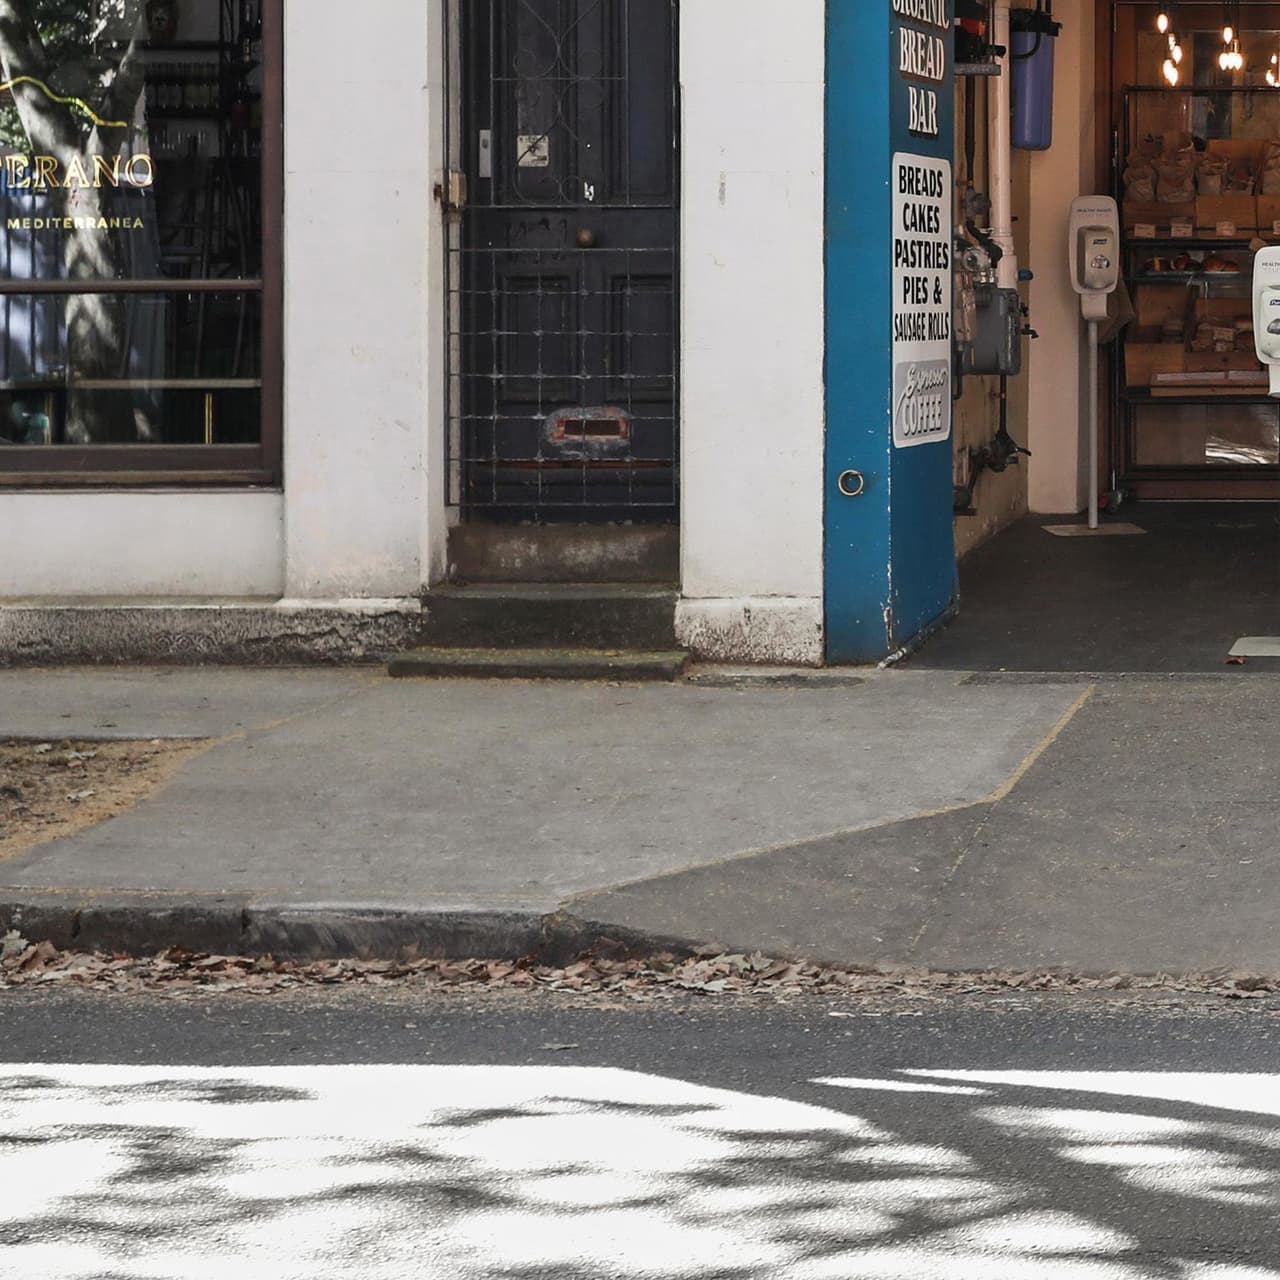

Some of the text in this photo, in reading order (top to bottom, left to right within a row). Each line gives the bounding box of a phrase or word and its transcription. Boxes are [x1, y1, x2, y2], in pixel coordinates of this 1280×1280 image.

[900, 27, 945, 81] BREAD
[908, 86, 938, 135] BAR
[0, 153, 155, 188] ERANO
[899, 165, 943, 198] BREADS
[7, 217, 144, 230] MEDITERRANEA
[903, 202, 940, 234] CAKES
[895, 238, 949, 270] PASTRIES
[903, 276, 942, 305] PIES &
[895, 312, 949, 342] SAUSAGE ROLLS
[902, 395, 942, 436] COFFEE
